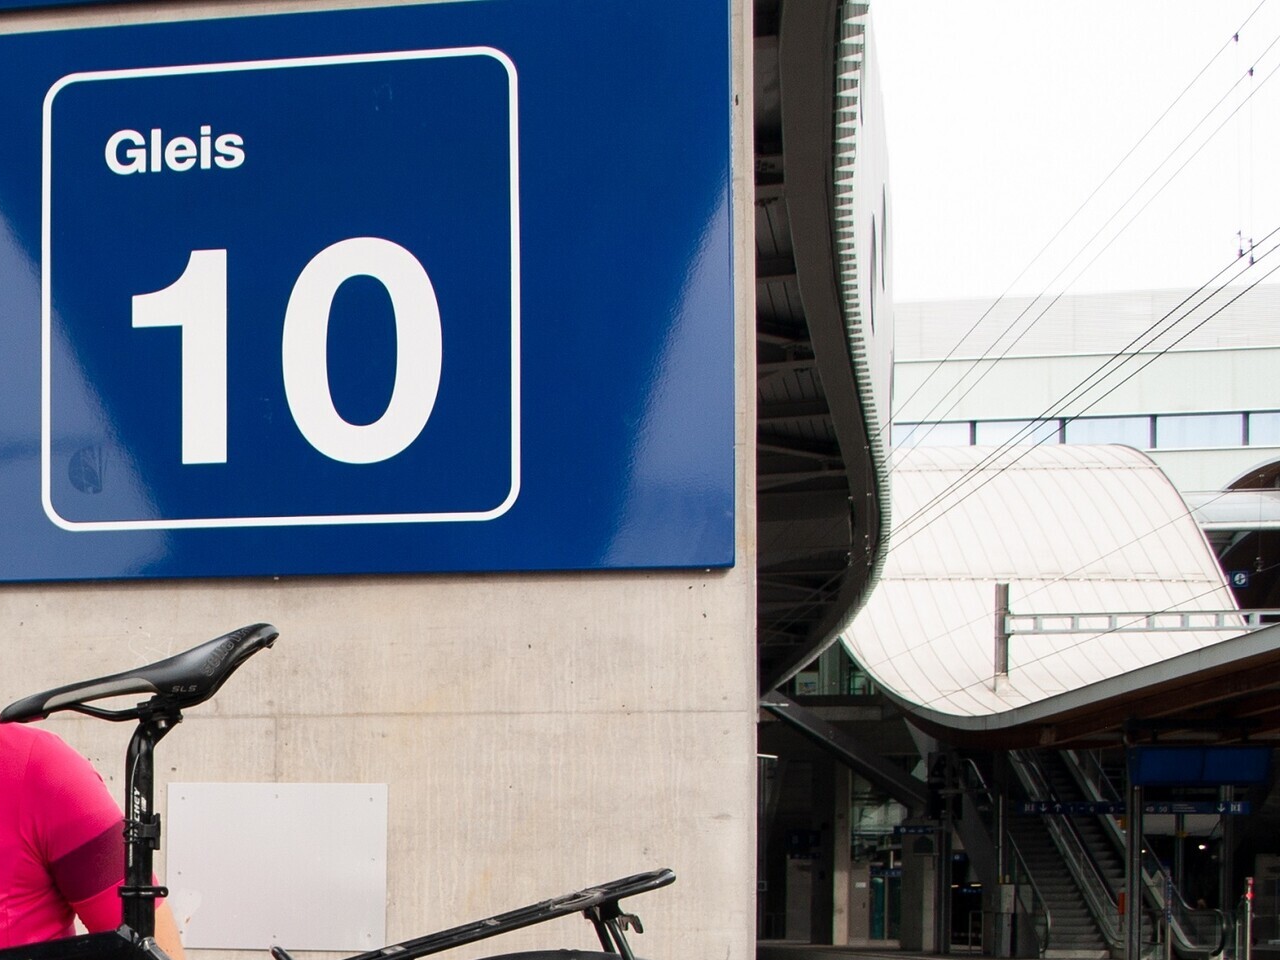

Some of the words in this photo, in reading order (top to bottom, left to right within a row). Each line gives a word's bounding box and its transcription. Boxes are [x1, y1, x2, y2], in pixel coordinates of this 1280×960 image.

[104, 124, 246, 176] Gleis
[131, 236, 443, 465] 10
[171, 684, 198, 693] SLS
